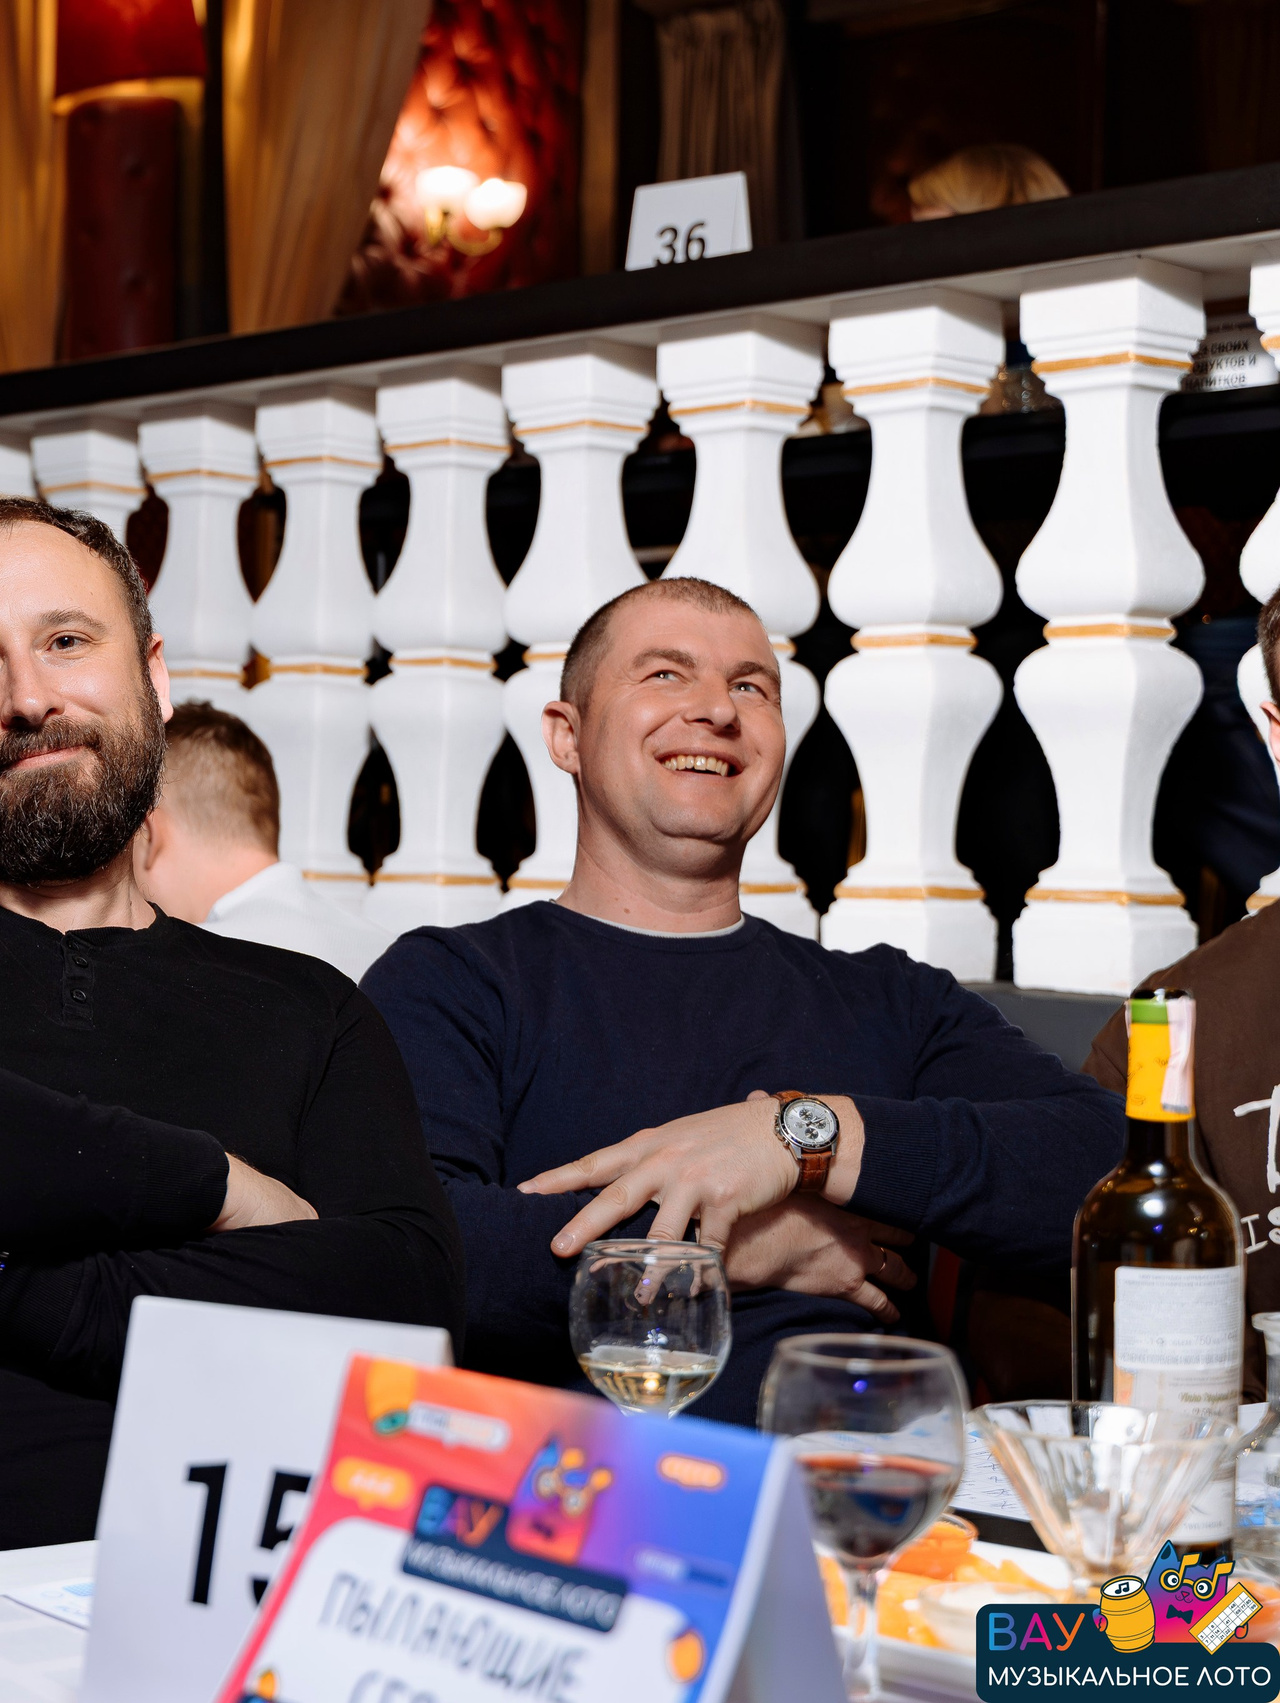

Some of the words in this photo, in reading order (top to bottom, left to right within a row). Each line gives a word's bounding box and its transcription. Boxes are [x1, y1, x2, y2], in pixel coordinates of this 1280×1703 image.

[658, 221, 706, 265] 36
[1211, 339, 1249, 355] СВОИХ
[1248, 354, 1257, 366] И
[416, 1485, 504, 1548] ВАУ
[319, 1571, 588, 1700] ПЫЛАЮЩИЕ
